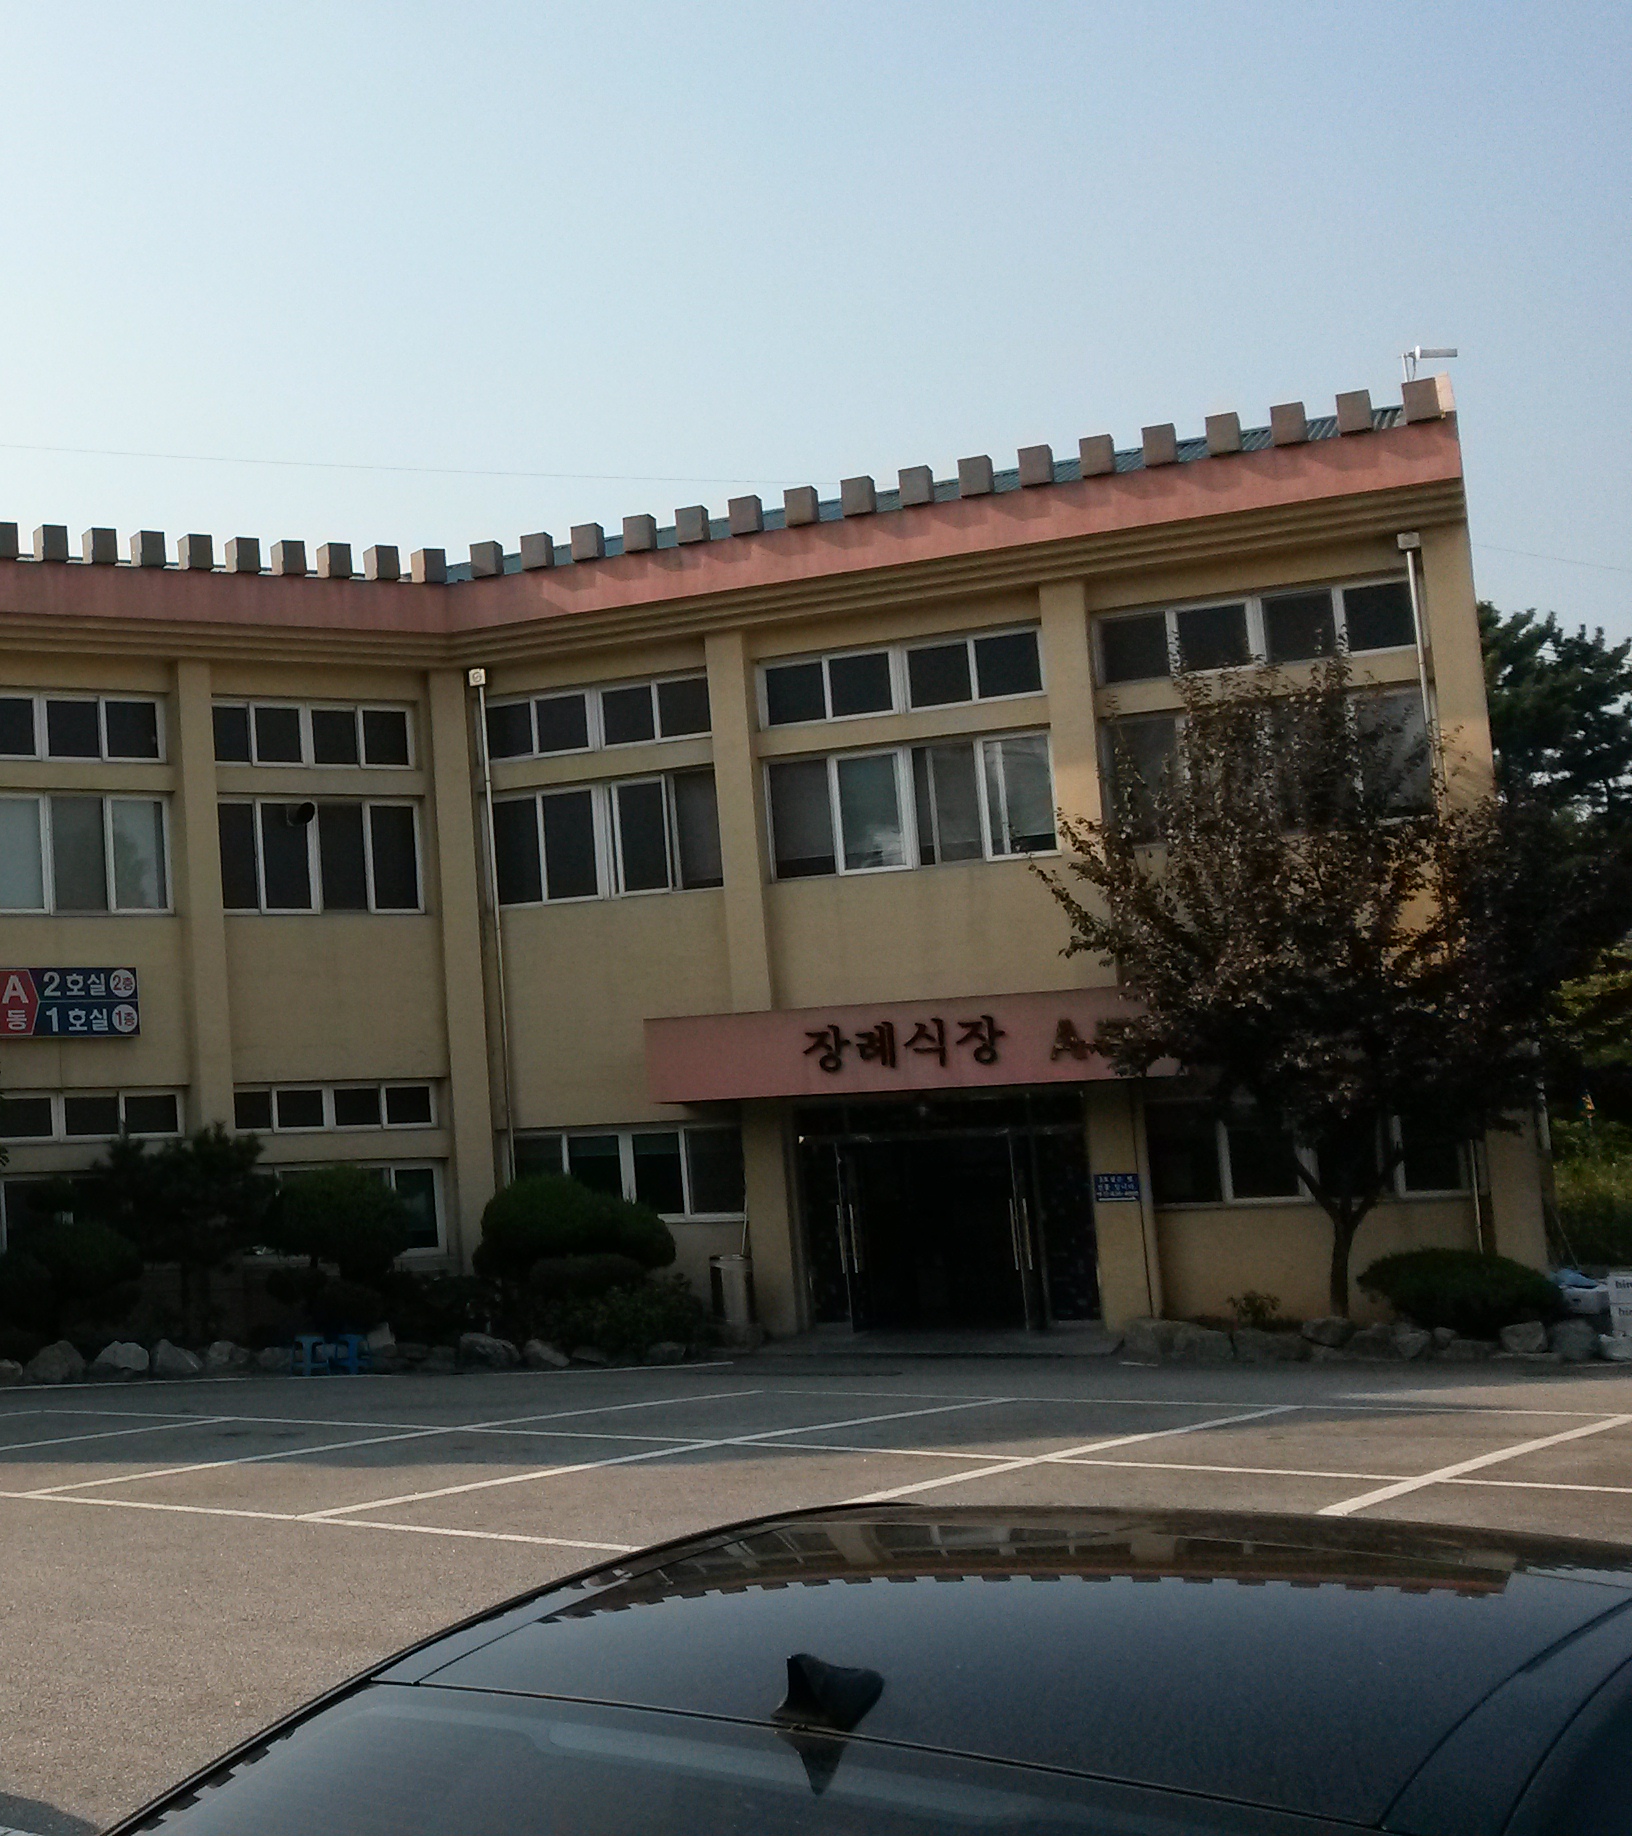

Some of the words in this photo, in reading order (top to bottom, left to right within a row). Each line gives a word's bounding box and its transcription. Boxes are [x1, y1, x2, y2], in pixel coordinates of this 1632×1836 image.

[1, 974, 29, 1004] A
[43, 971, 105, 997] 2호실
[6, 1009, 27, 1031] 동
[46, 1006, 109, 1033] 1호실
[802, 1015, 1006, 1072] 장례식장
